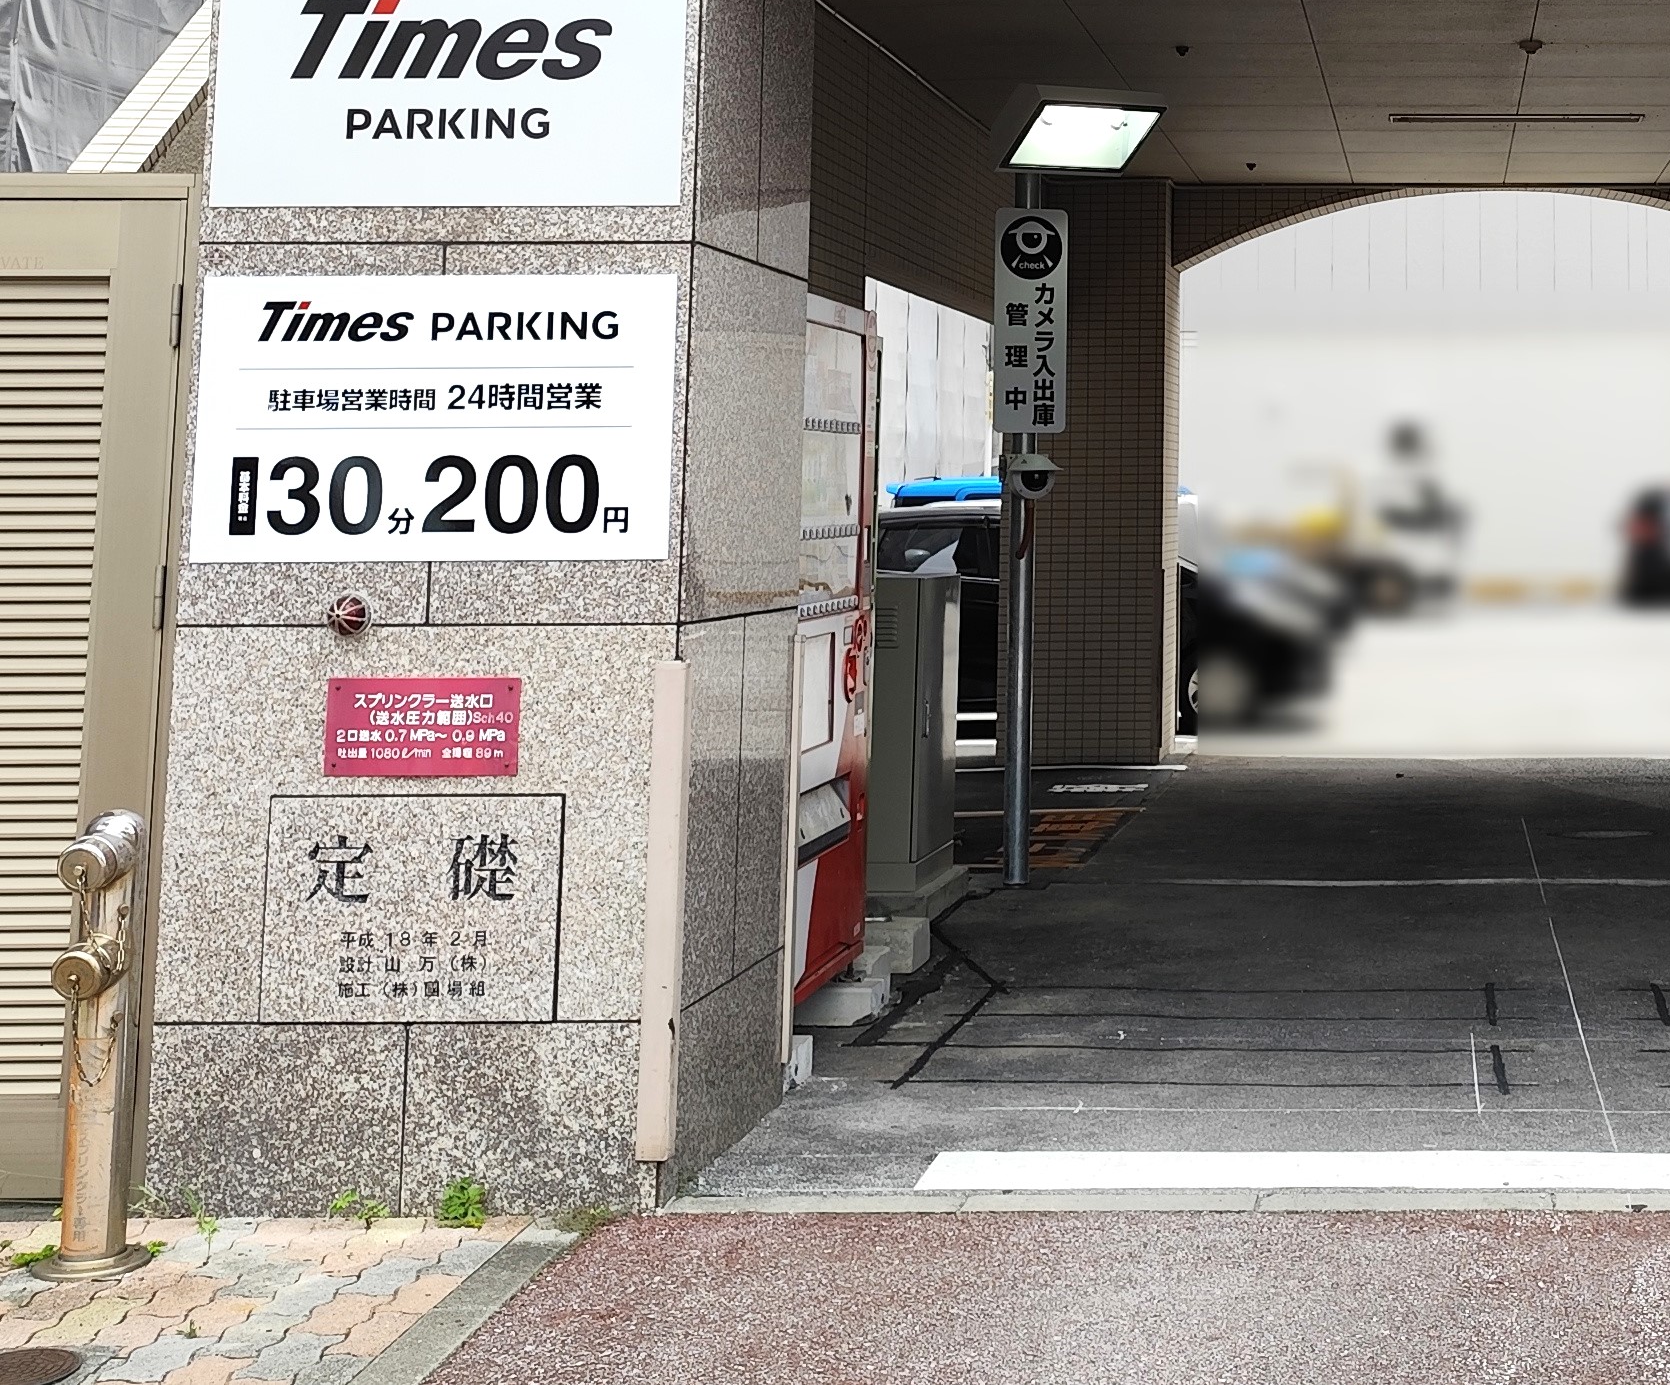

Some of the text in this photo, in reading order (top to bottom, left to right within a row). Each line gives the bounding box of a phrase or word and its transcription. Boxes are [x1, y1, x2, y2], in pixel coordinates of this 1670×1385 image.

[345, 107, 551, 140] PARKING
[1018, 260, 1046, 270] check
[257, 300, 620, 342] Times PARKING
[1004, 302, 1029, 411] 管理中
[1032, 282, 1055, 427] カメラ入出庫
[268, 382, 603, 412] 駐車場営業時間 24時間営業
[354, 694, 493, 709] スプリンクラー送水口
[479, 728, 506, 742] MPa
